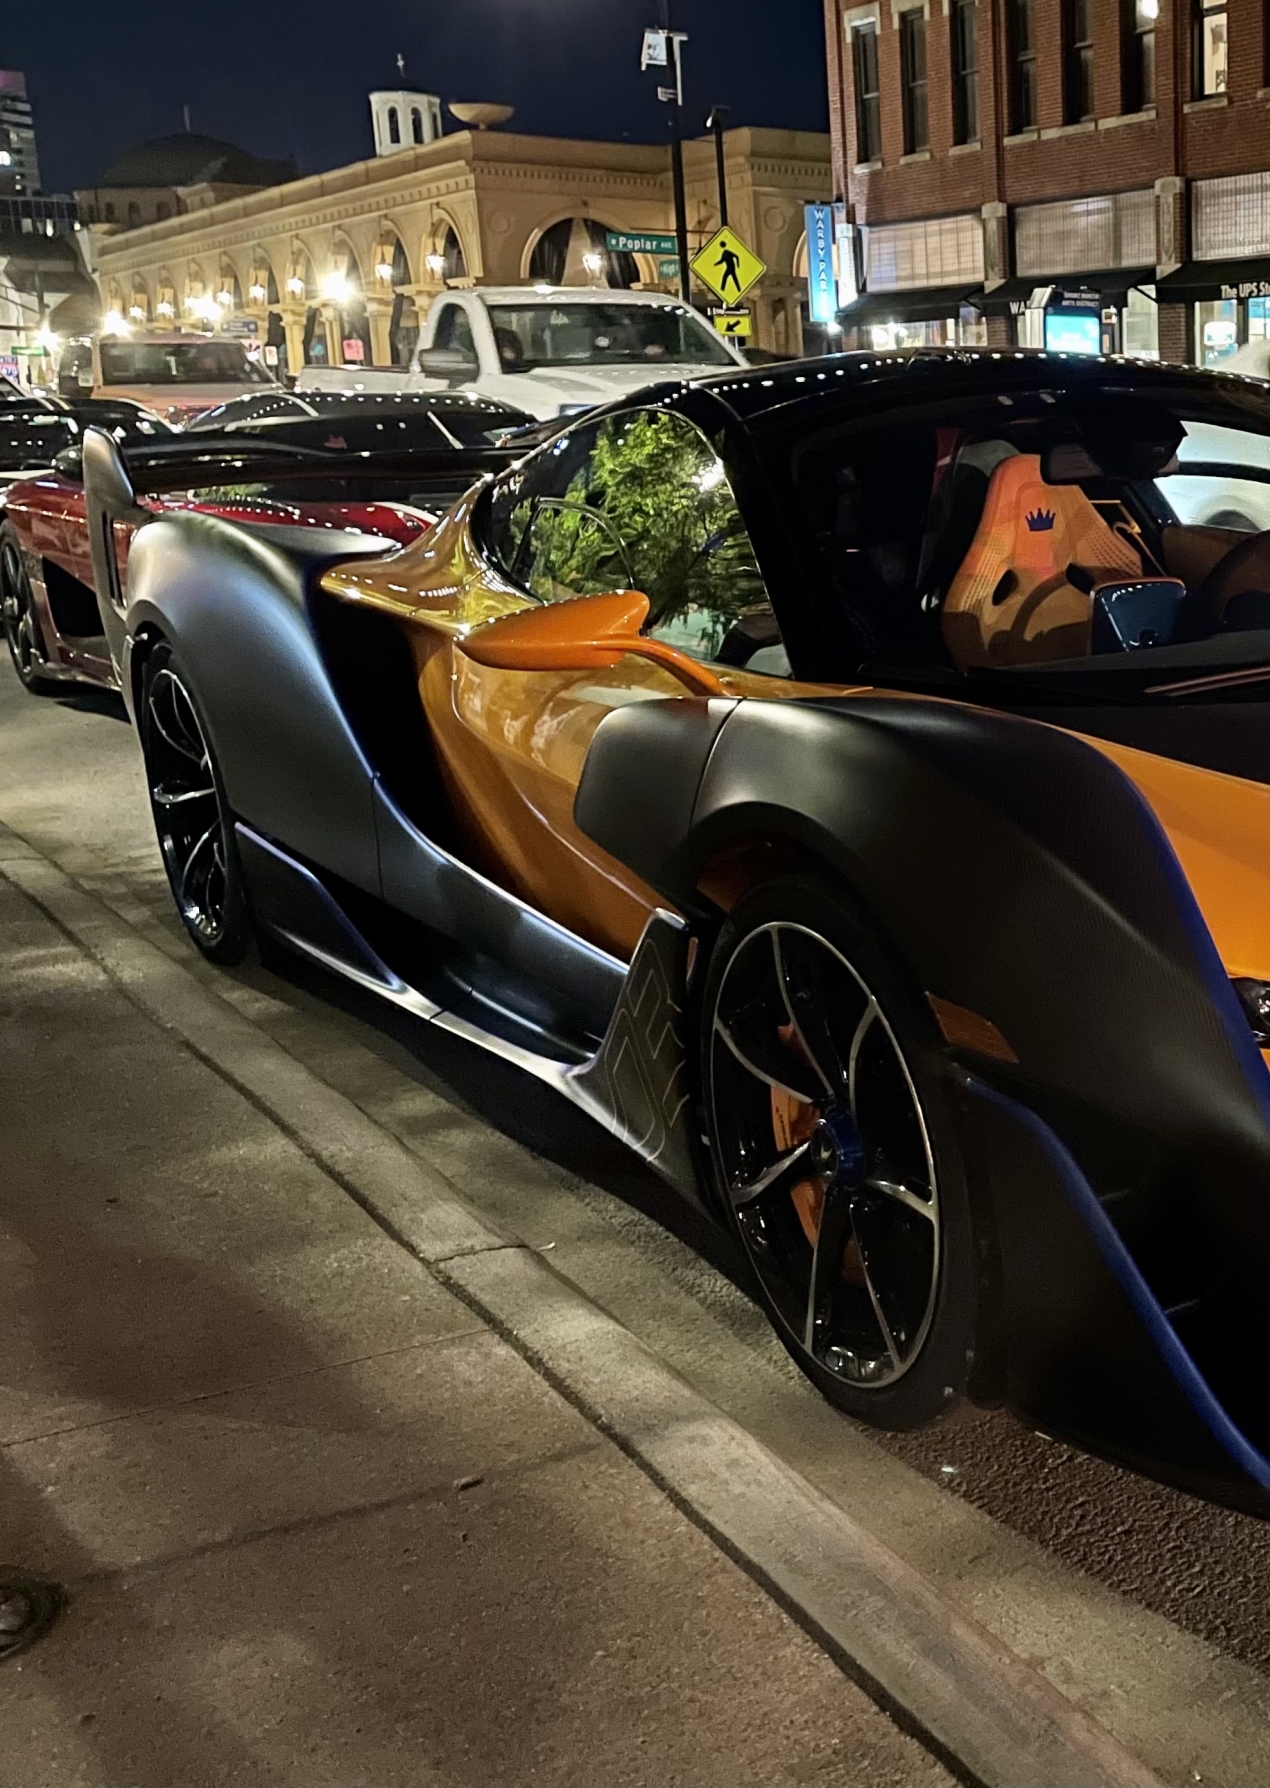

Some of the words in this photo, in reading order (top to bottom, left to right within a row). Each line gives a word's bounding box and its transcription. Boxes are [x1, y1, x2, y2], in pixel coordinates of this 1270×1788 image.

[813, 208, 826, 257] WARBY
[619, 236, 657, 250] Poplar
[1221, 285, 1238, 298] The
[1239, 283, 1258, 297] UPS
